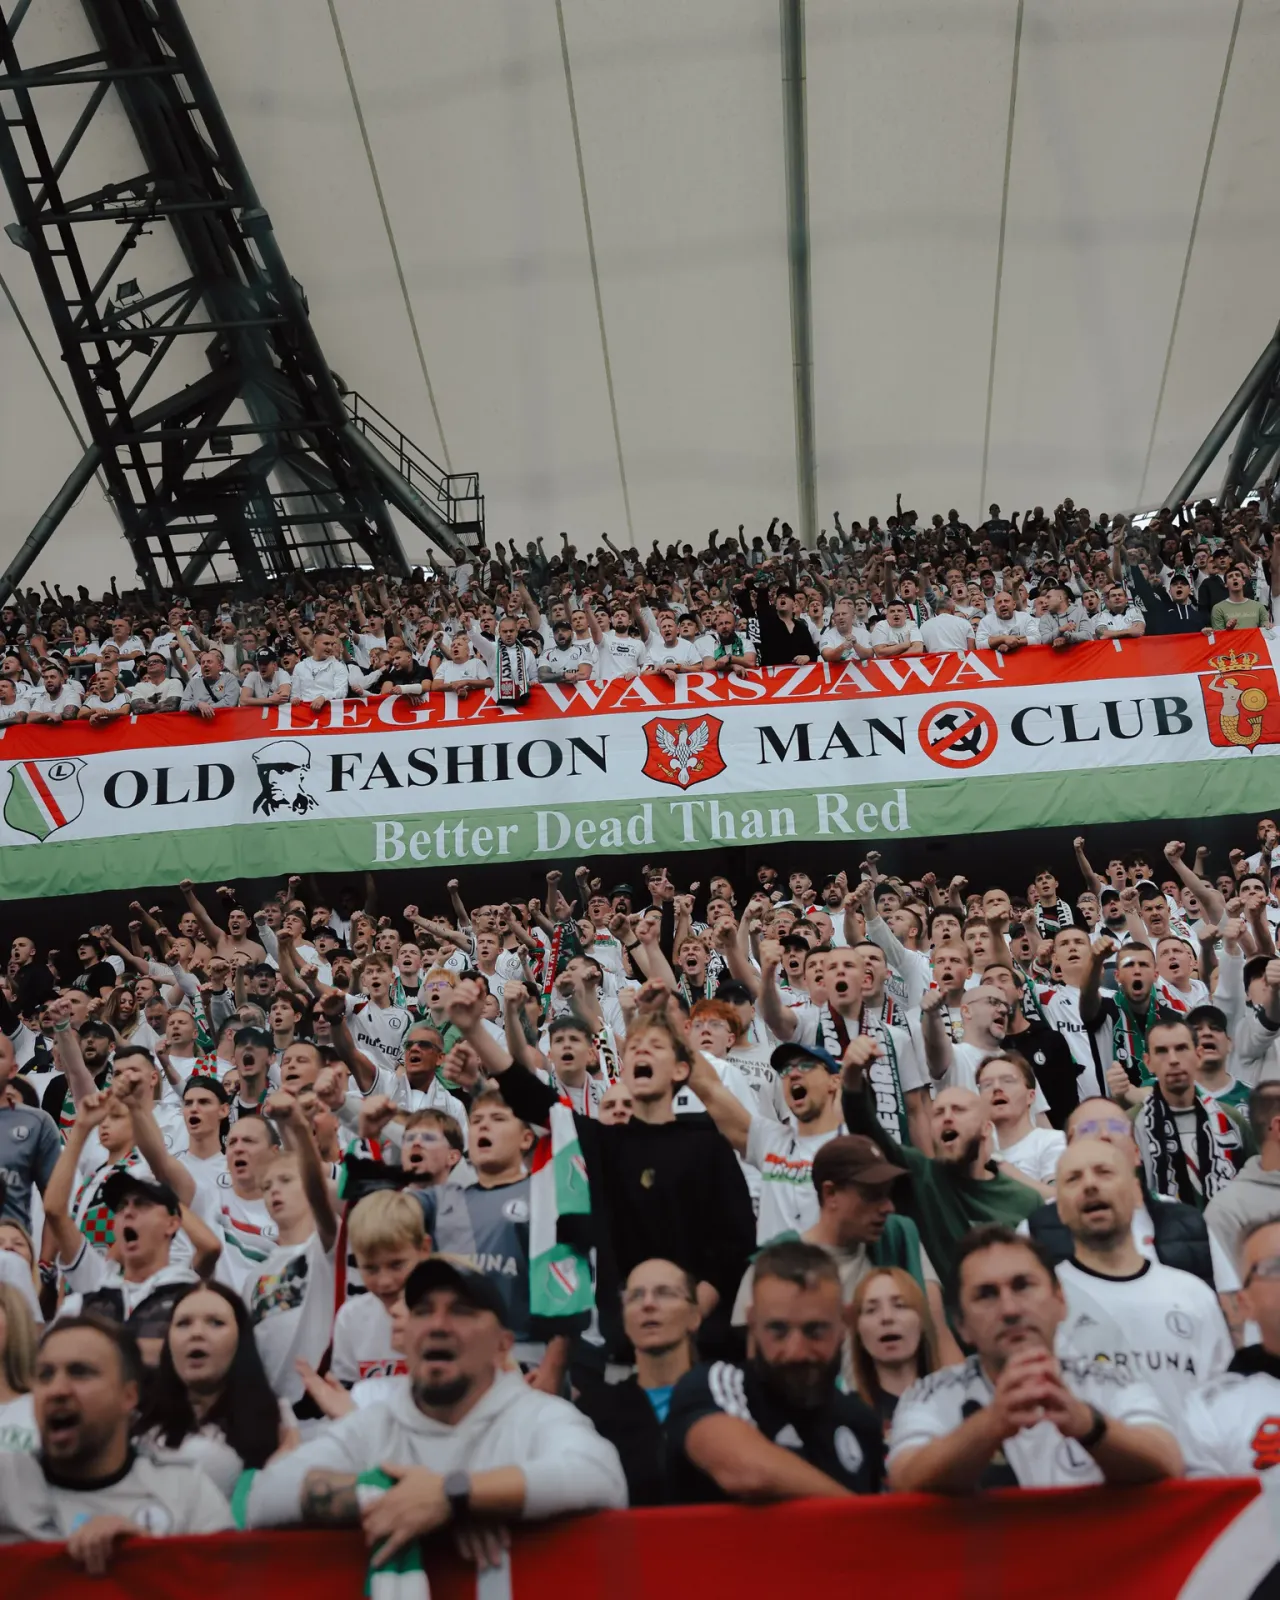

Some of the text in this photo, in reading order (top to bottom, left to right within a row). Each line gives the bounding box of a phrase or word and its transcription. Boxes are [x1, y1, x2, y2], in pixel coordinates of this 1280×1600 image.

[271, 689, 524, 732] LEGIA
[541, 650, 1003, 712] WARSZAWA
[103, 696, 1193, 809] OLD FASHION MAN CLUB
[371, 788, 911, 864] Better Dead Than Red
